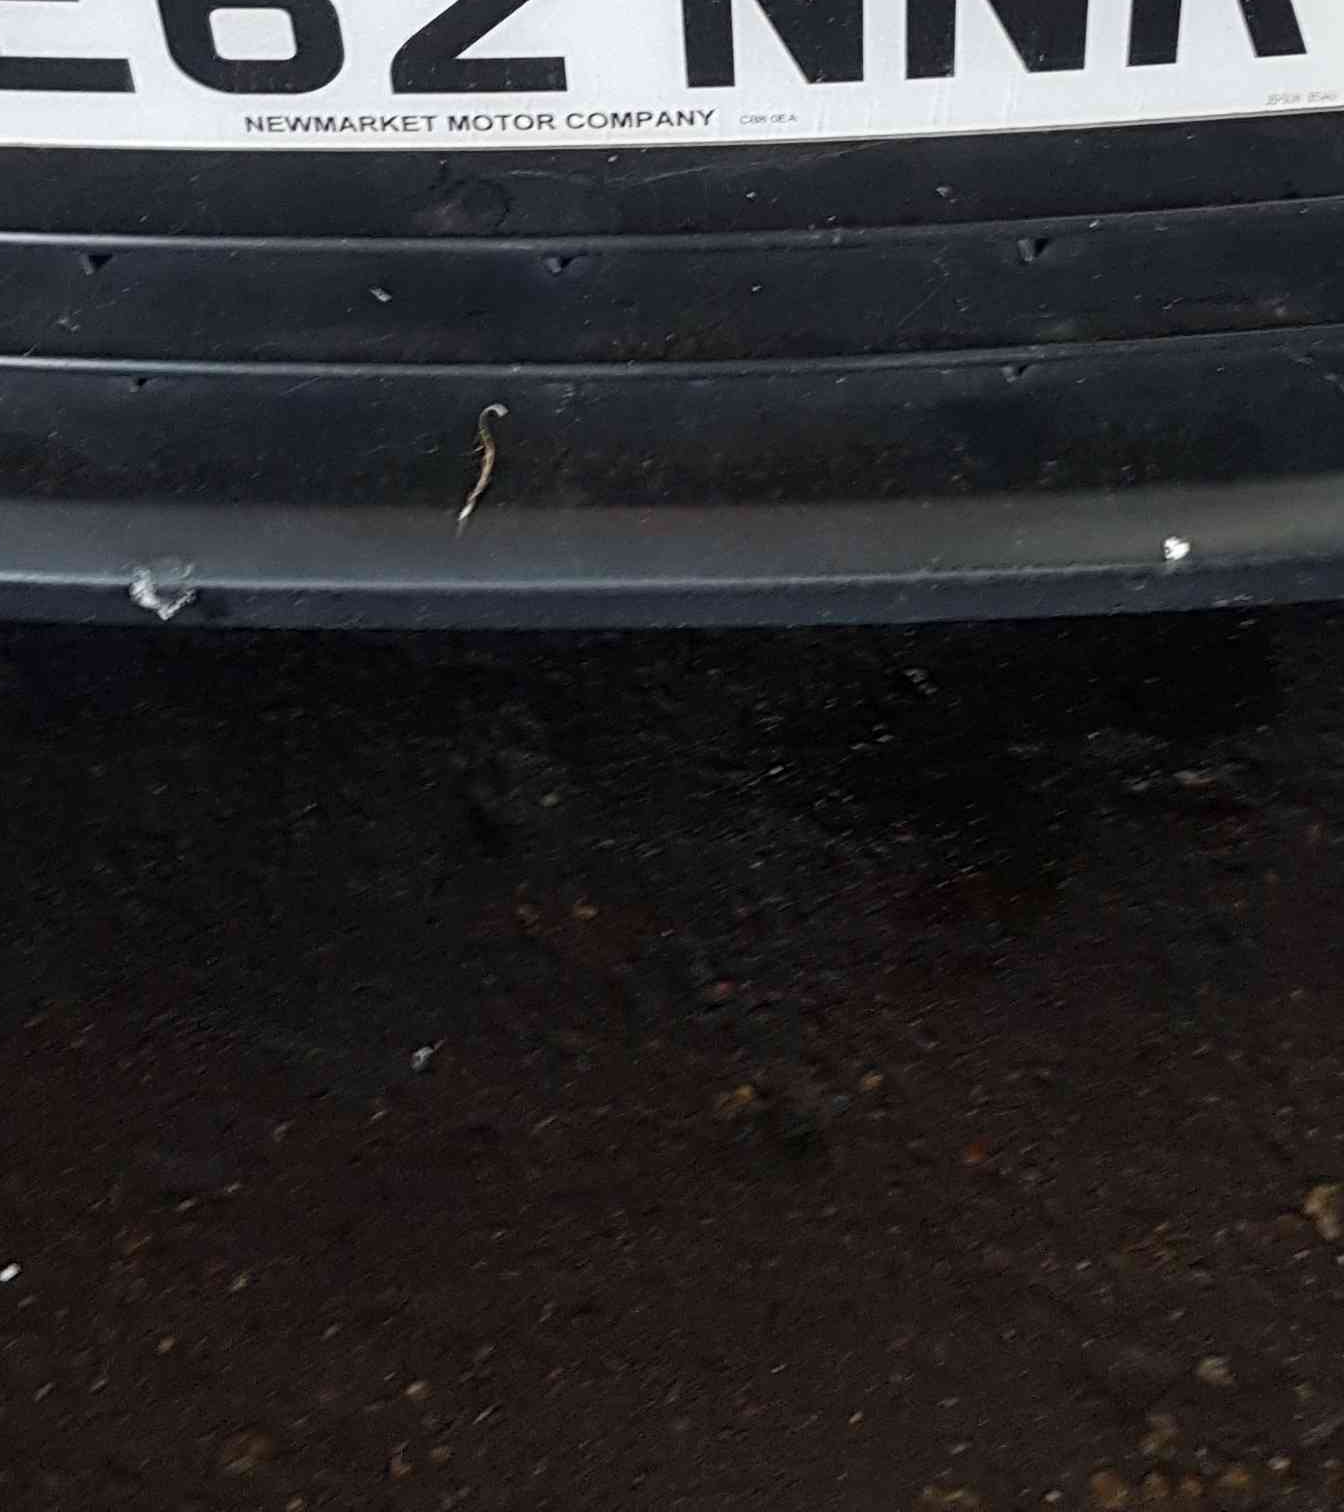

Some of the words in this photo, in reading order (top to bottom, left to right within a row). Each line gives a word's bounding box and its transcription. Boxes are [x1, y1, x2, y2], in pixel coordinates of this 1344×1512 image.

[244, 115, 436, 133] NEWMARKET
[447, 113, 556, 132] MOTOR
[565, 109, 715, 130] COMPANY
